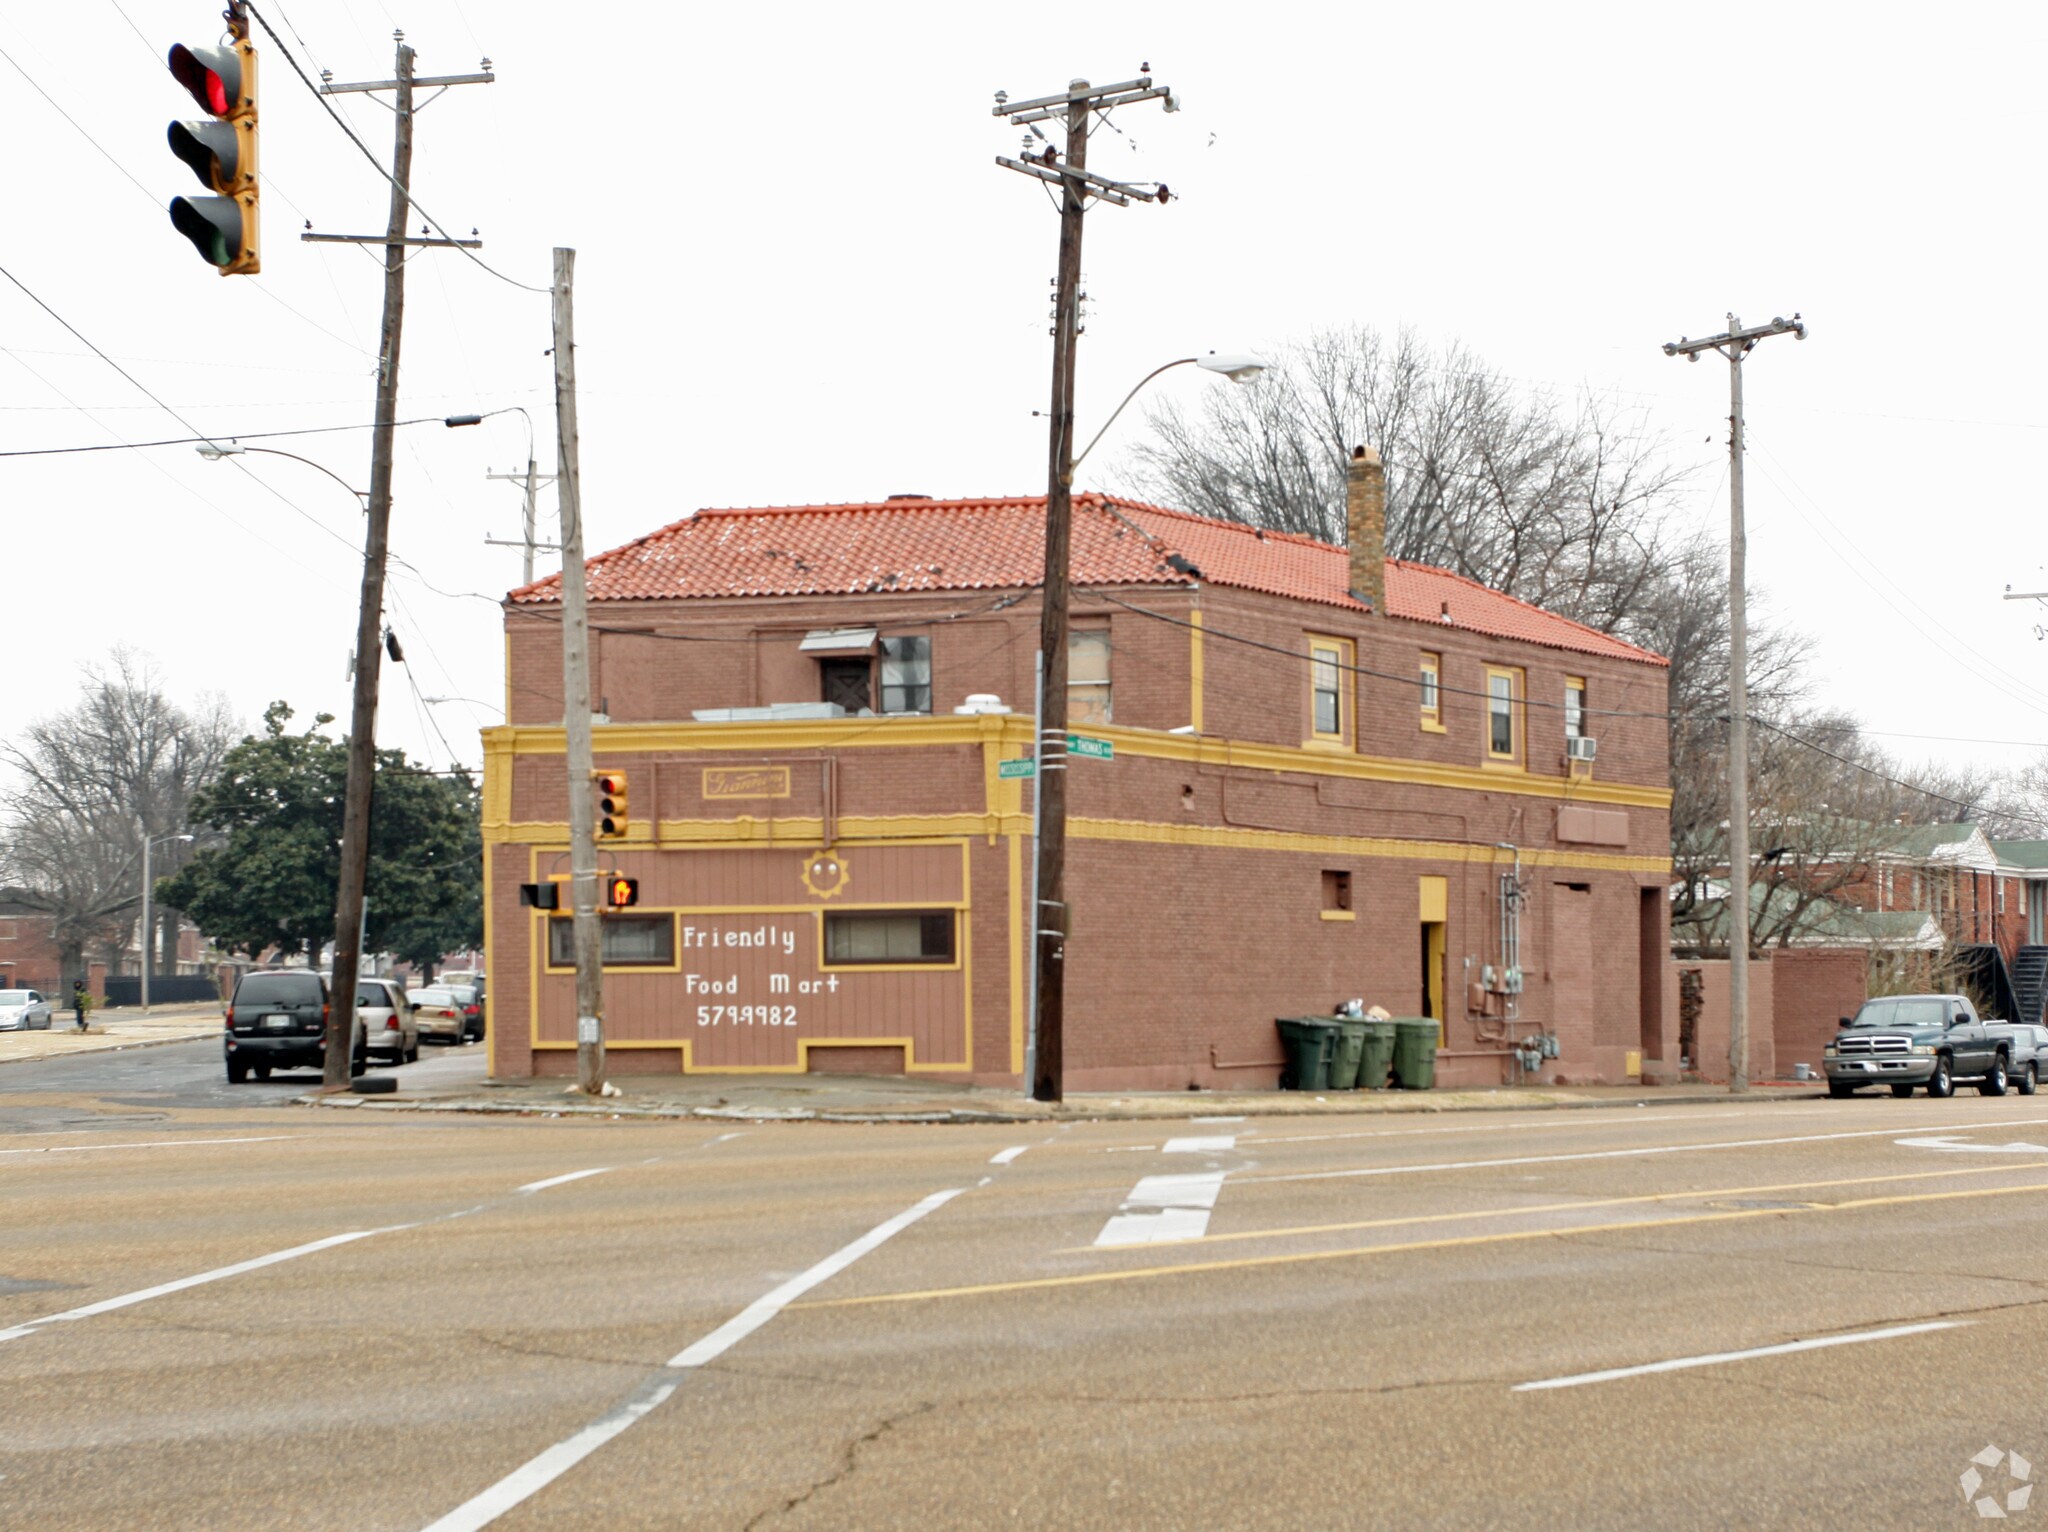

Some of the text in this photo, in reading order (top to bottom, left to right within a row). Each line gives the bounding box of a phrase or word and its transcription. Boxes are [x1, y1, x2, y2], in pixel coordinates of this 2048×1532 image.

[1077, 739, 1103, 756] THOMAS
[683, 926, 795, 955] Friendly
[685, 974, 738, 995] Food
